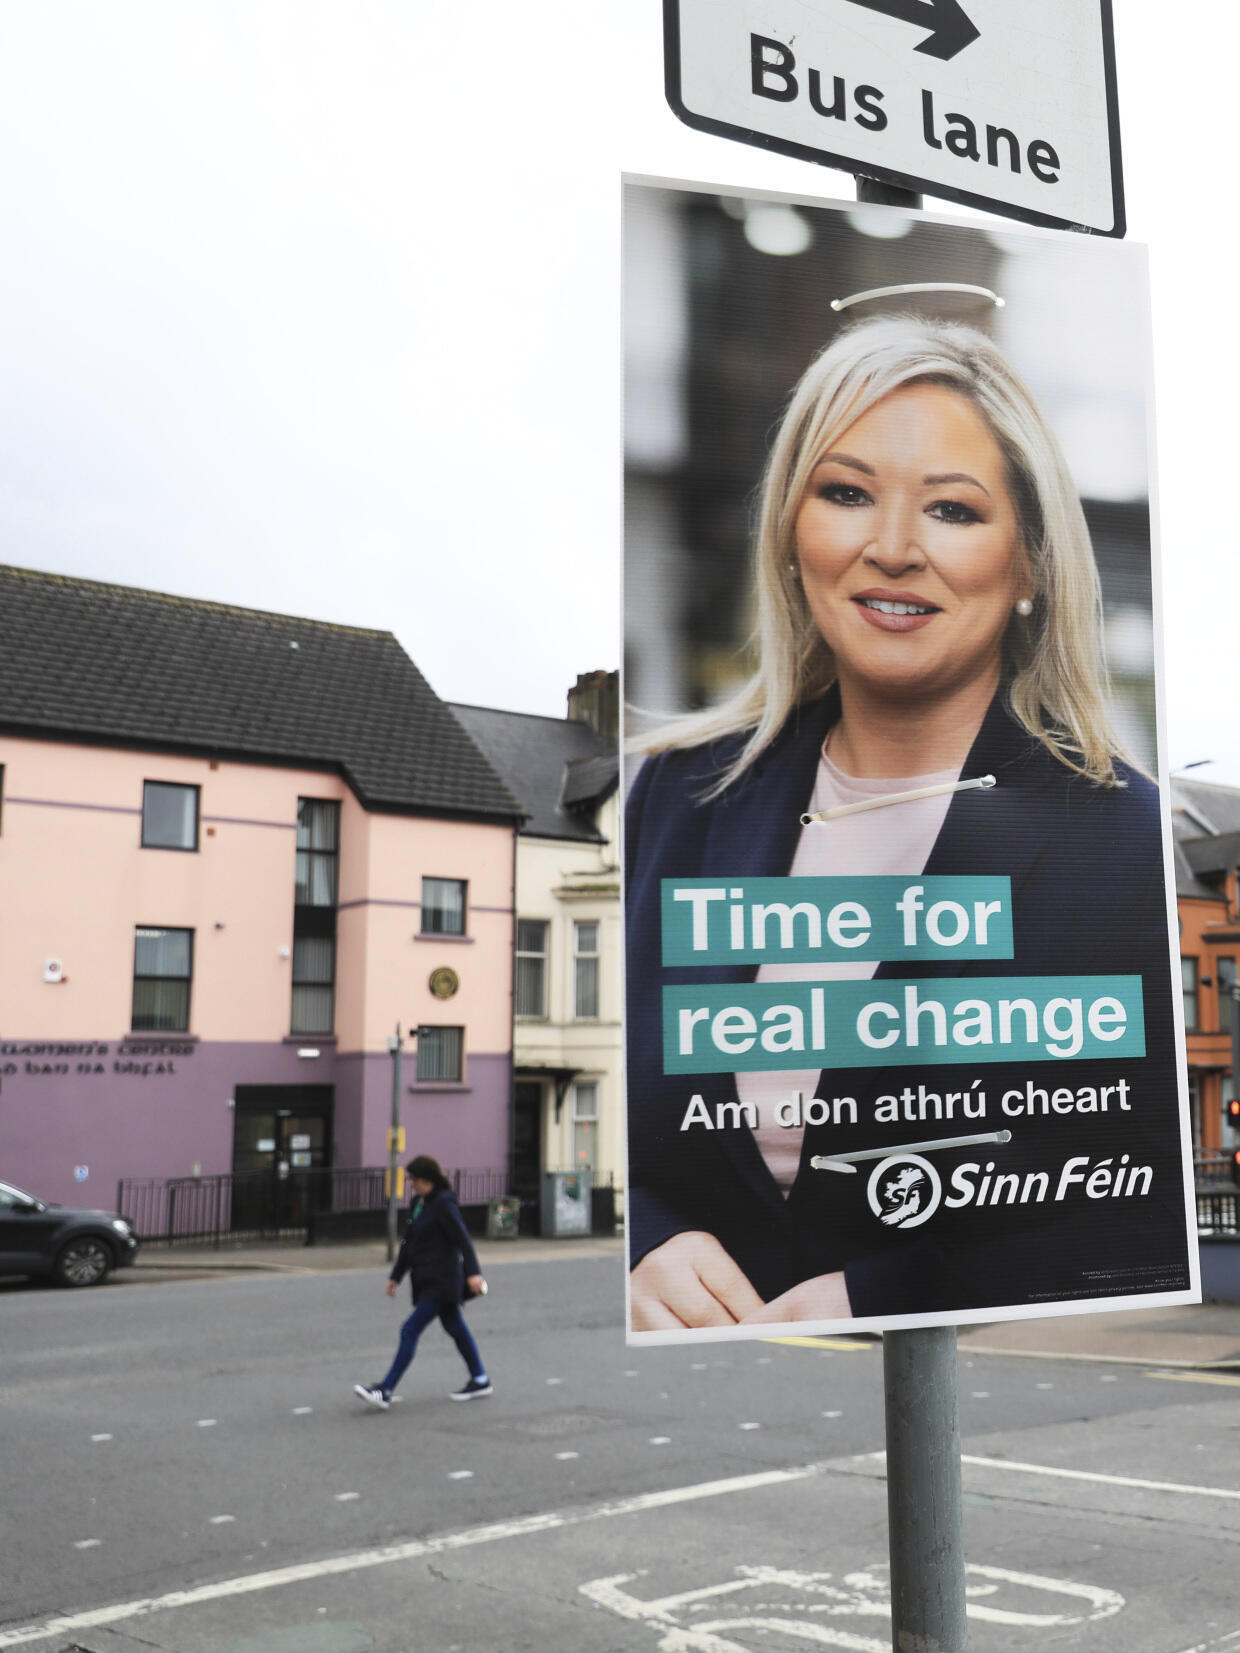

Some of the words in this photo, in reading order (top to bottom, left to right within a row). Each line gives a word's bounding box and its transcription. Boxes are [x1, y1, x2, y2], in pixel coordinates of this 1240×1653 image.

[750, 32, 889, 132] Bus
[921, 88, 1061, 184] lane
[674, 887, 872, 951] Time
[896, 885, 1001, 947] for
[678, 988, 826, 1056] real
[856, 986, 1128, 1058] change
[680, 1094, 759, 1132] Am
[773, 1090, 859, 1128] don
[874, 1079, 986, 1123] athrú
[1001, 1078, 1132, 1118] cheart
[944, 1161, 1049, 1209] Sinn
[1055, 1154, 1154, 1203] Féin
